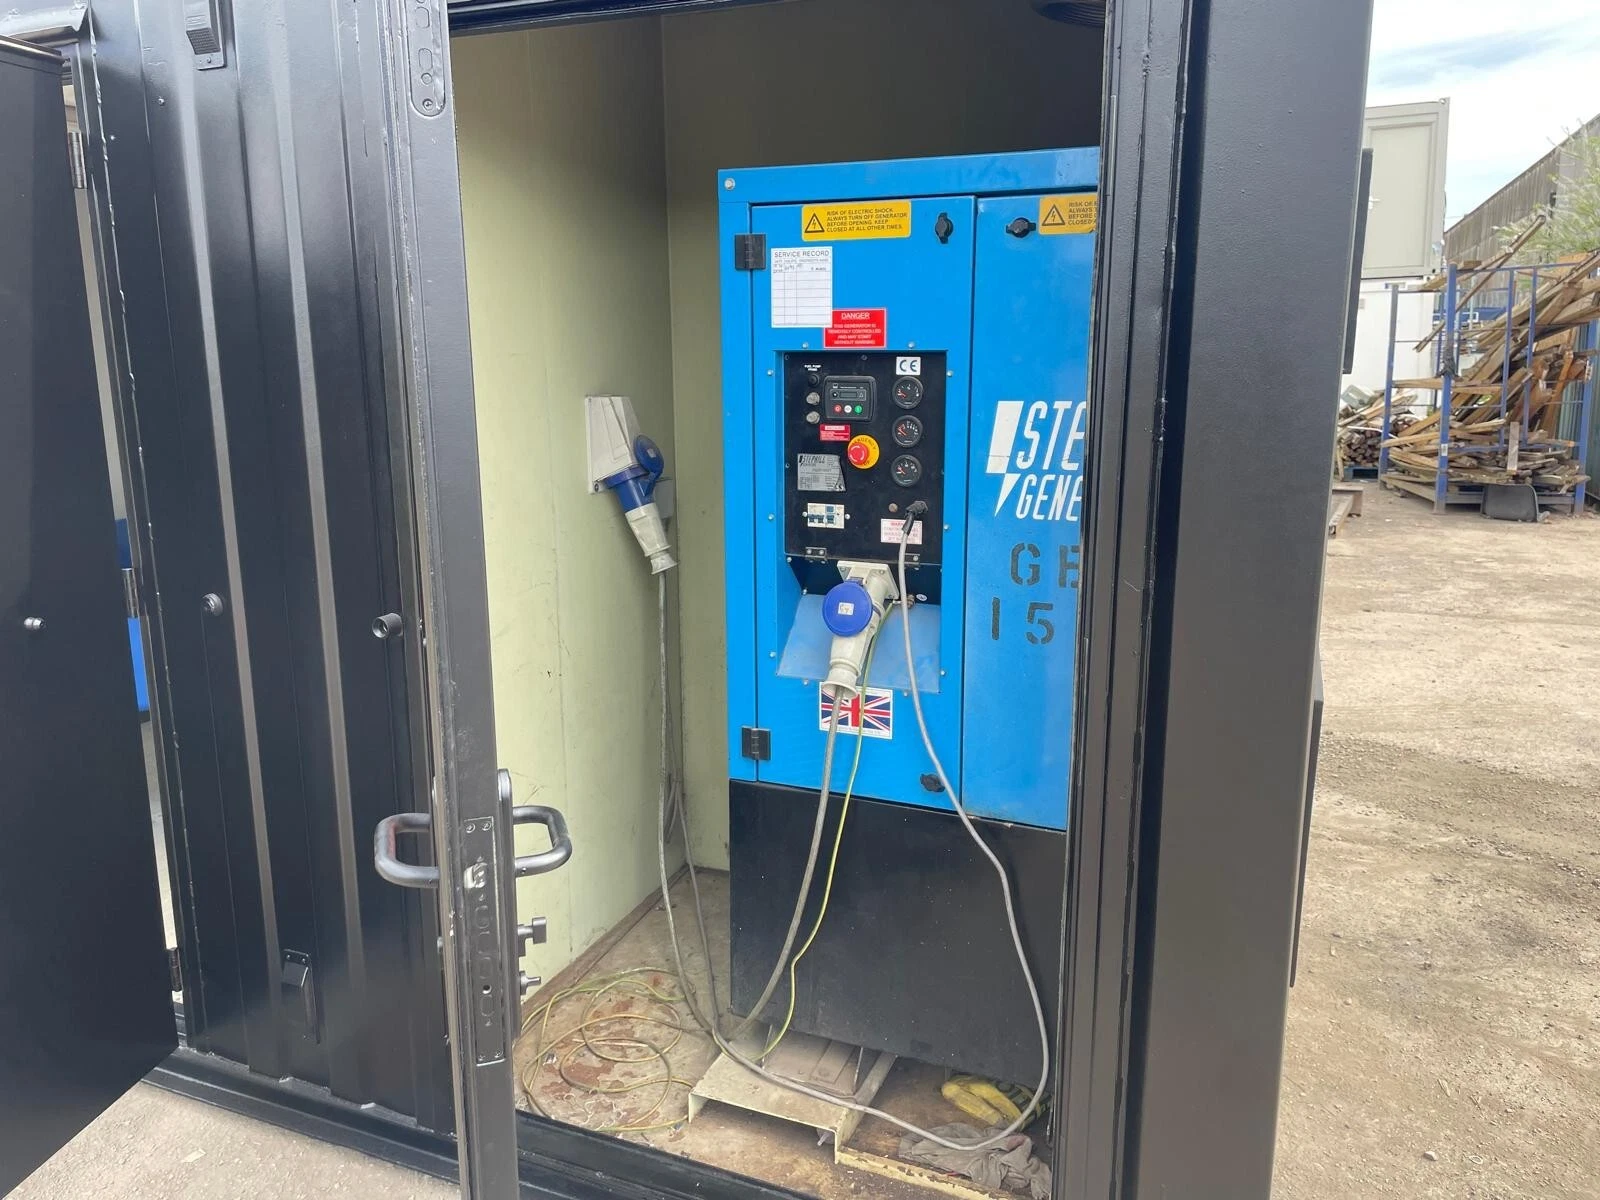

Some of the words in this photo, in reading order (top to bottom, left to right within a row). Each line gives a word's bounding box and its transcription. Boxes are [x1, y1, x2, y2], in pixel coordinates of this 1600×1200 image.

[841, 312, 870, 320] DANGER
[900, 359, 918, 372] CE
[1016, 400, 1086, 471] STE
[1016, 473, 1083, 522] GENE
